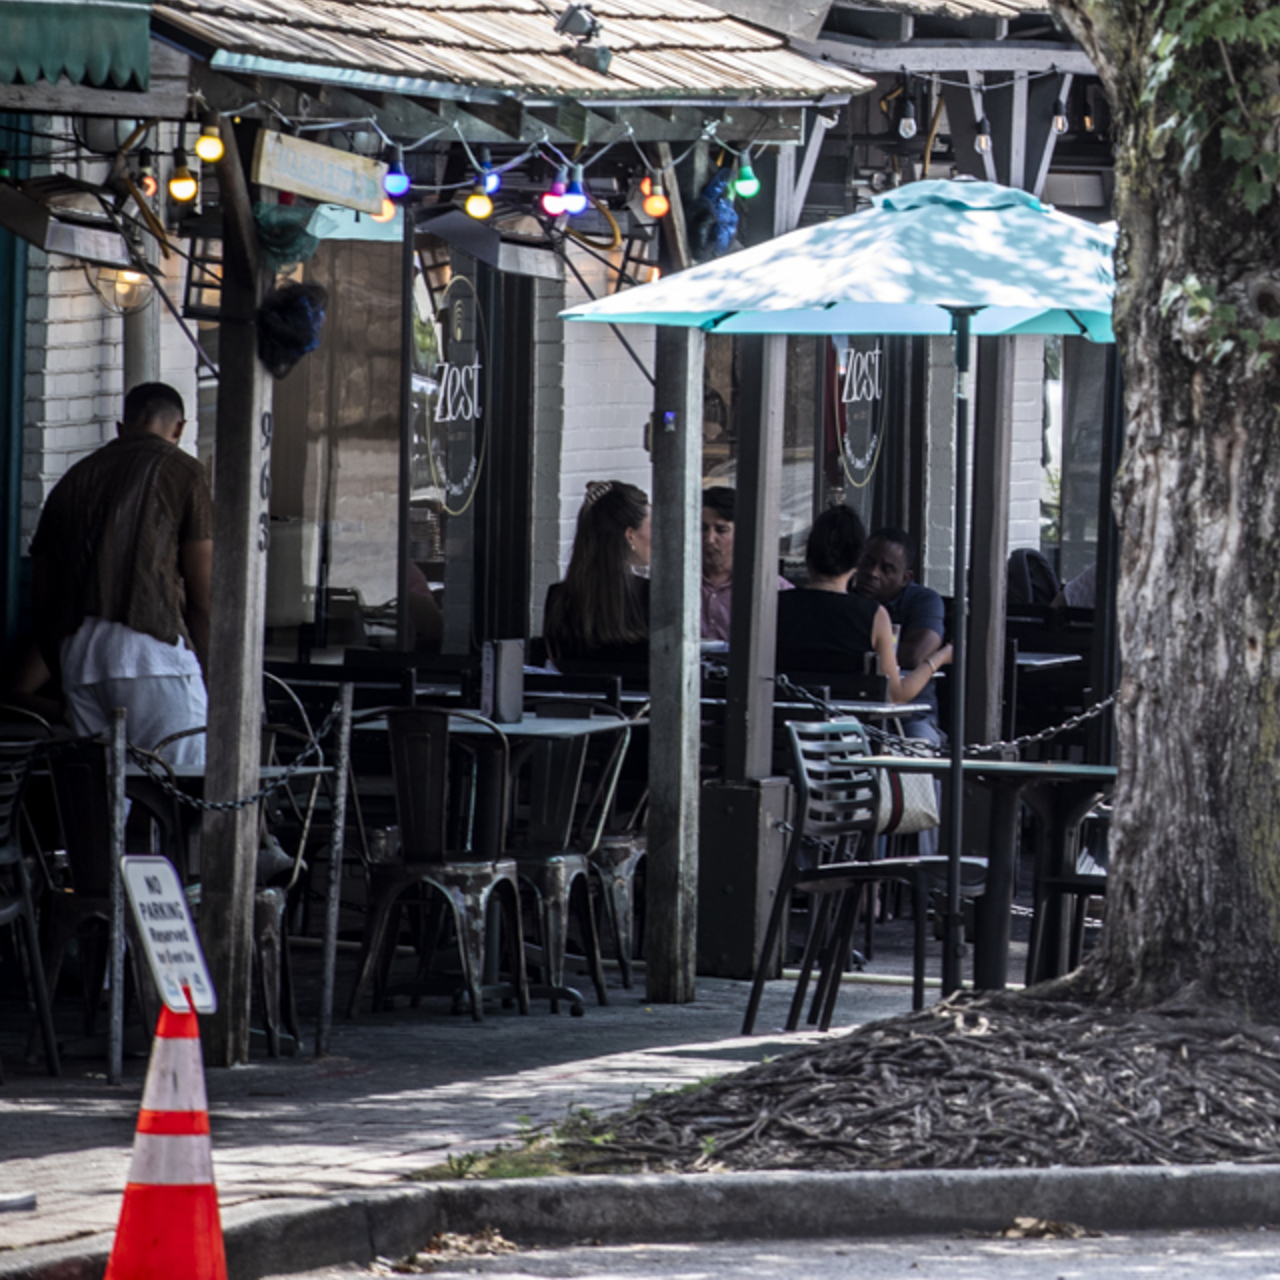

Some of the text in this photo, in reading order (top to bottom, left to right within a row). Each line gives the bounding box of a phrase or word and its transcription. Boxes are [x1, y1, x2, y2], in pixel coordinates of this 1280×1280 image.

[144, 875, 163, 896] NO
[139, 901, 184, 921] PARKING
[148, 927, 190, 943] Reserved
